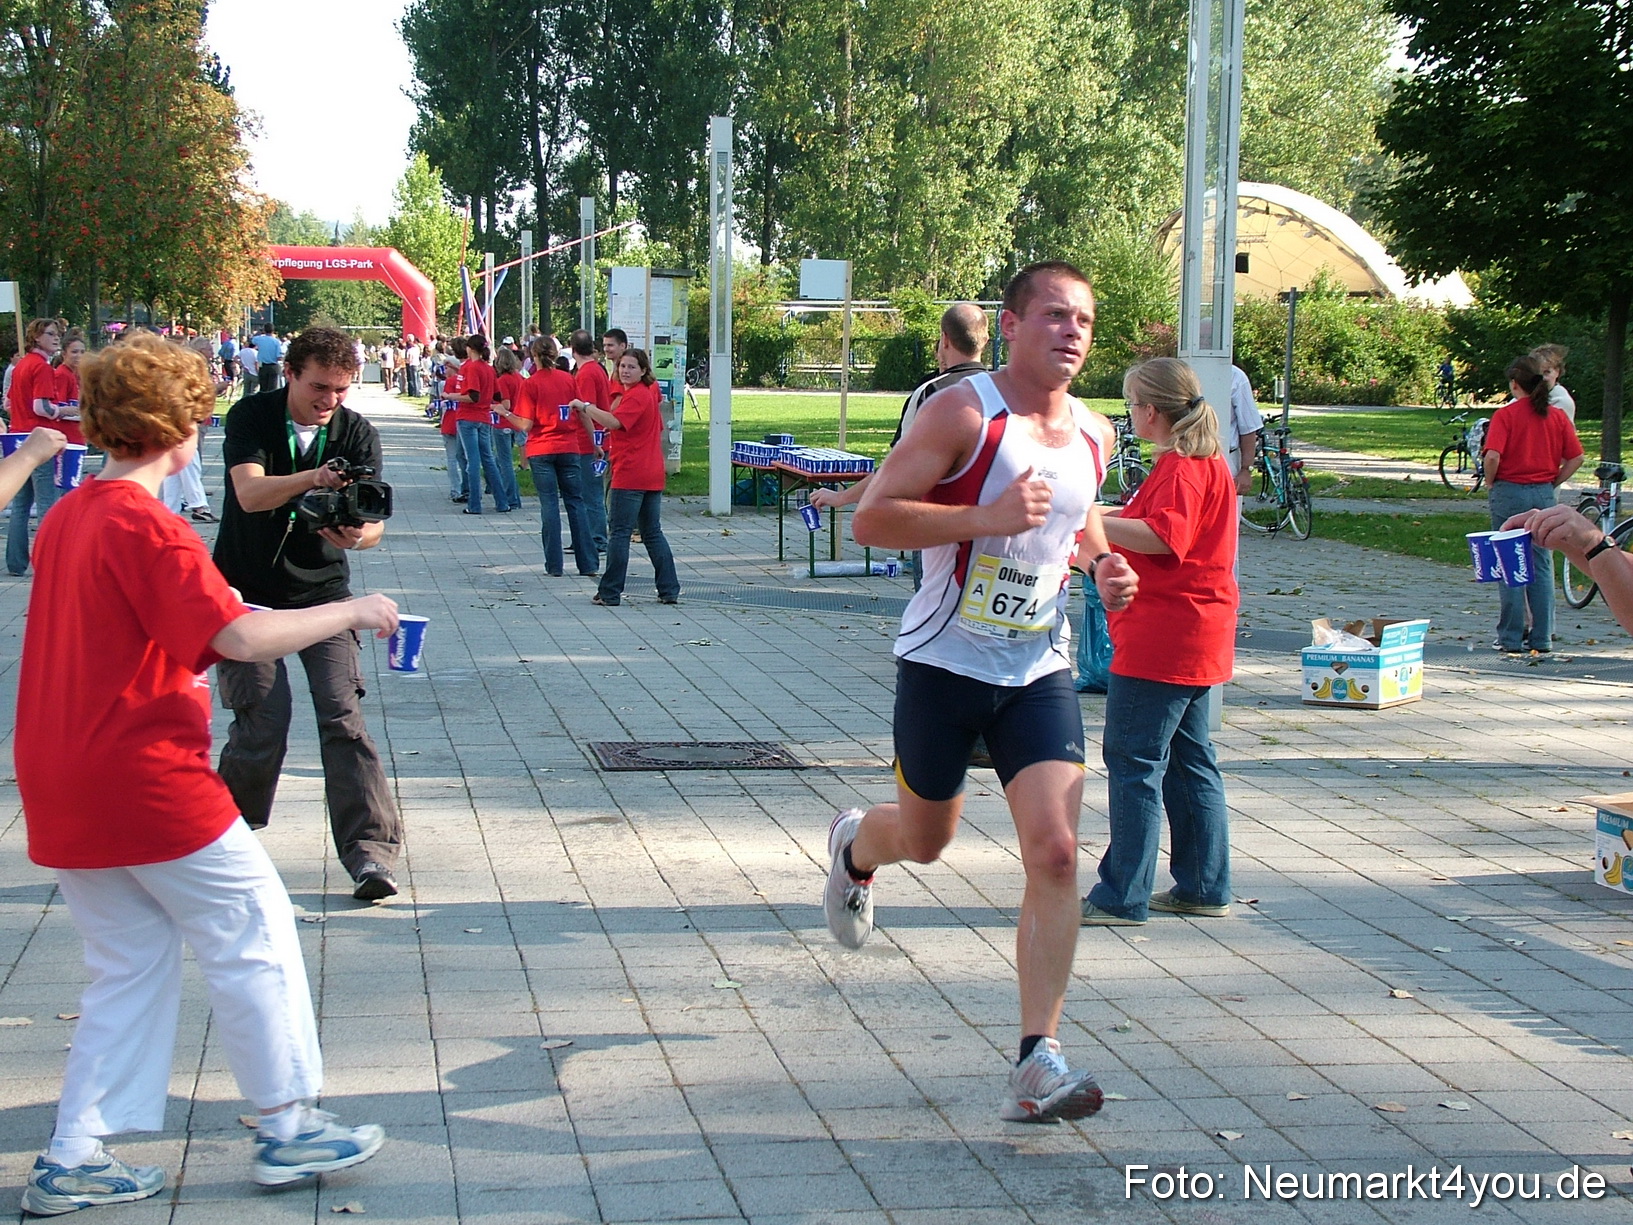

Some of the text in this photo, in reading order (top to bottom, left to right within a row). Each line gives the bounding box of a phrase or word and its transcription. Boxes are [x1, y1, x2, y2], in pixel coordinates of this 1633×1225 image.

[325, 259, 374, 269] LGS-Park
[1513, 541, 1529, 583] Xenofit
[998, 566, 1039, 588] Oliver
[972, 583, 984, 597] A
[991, 592, 1039, 621] 674
[1306, 653, 1338, 662] PREMIUM
[1341, 655, 1375, 664] BANANAS
